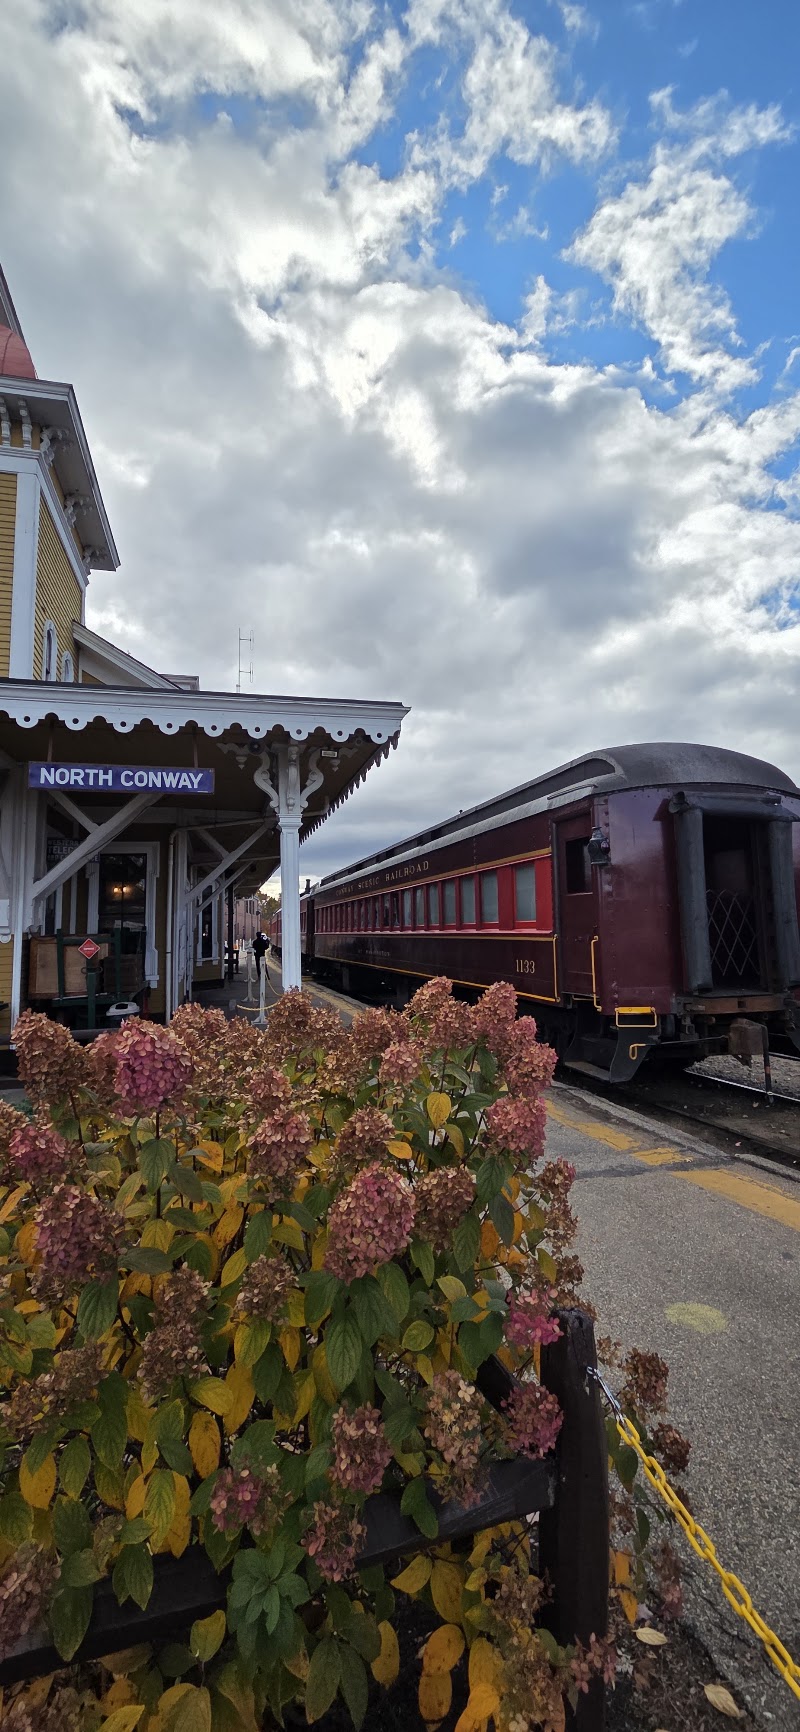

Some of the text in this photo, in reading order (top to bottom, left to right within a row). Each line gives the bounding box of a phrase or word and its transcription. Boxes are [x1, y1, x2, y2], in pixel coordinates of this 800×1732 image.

[39, 767, 204, 789] NORTH CONWAY
[358, 876, 380, 889] SCENIC
[385, 860, 429, 881] RAILROAD
[516, 959, 536, 974] 1133
